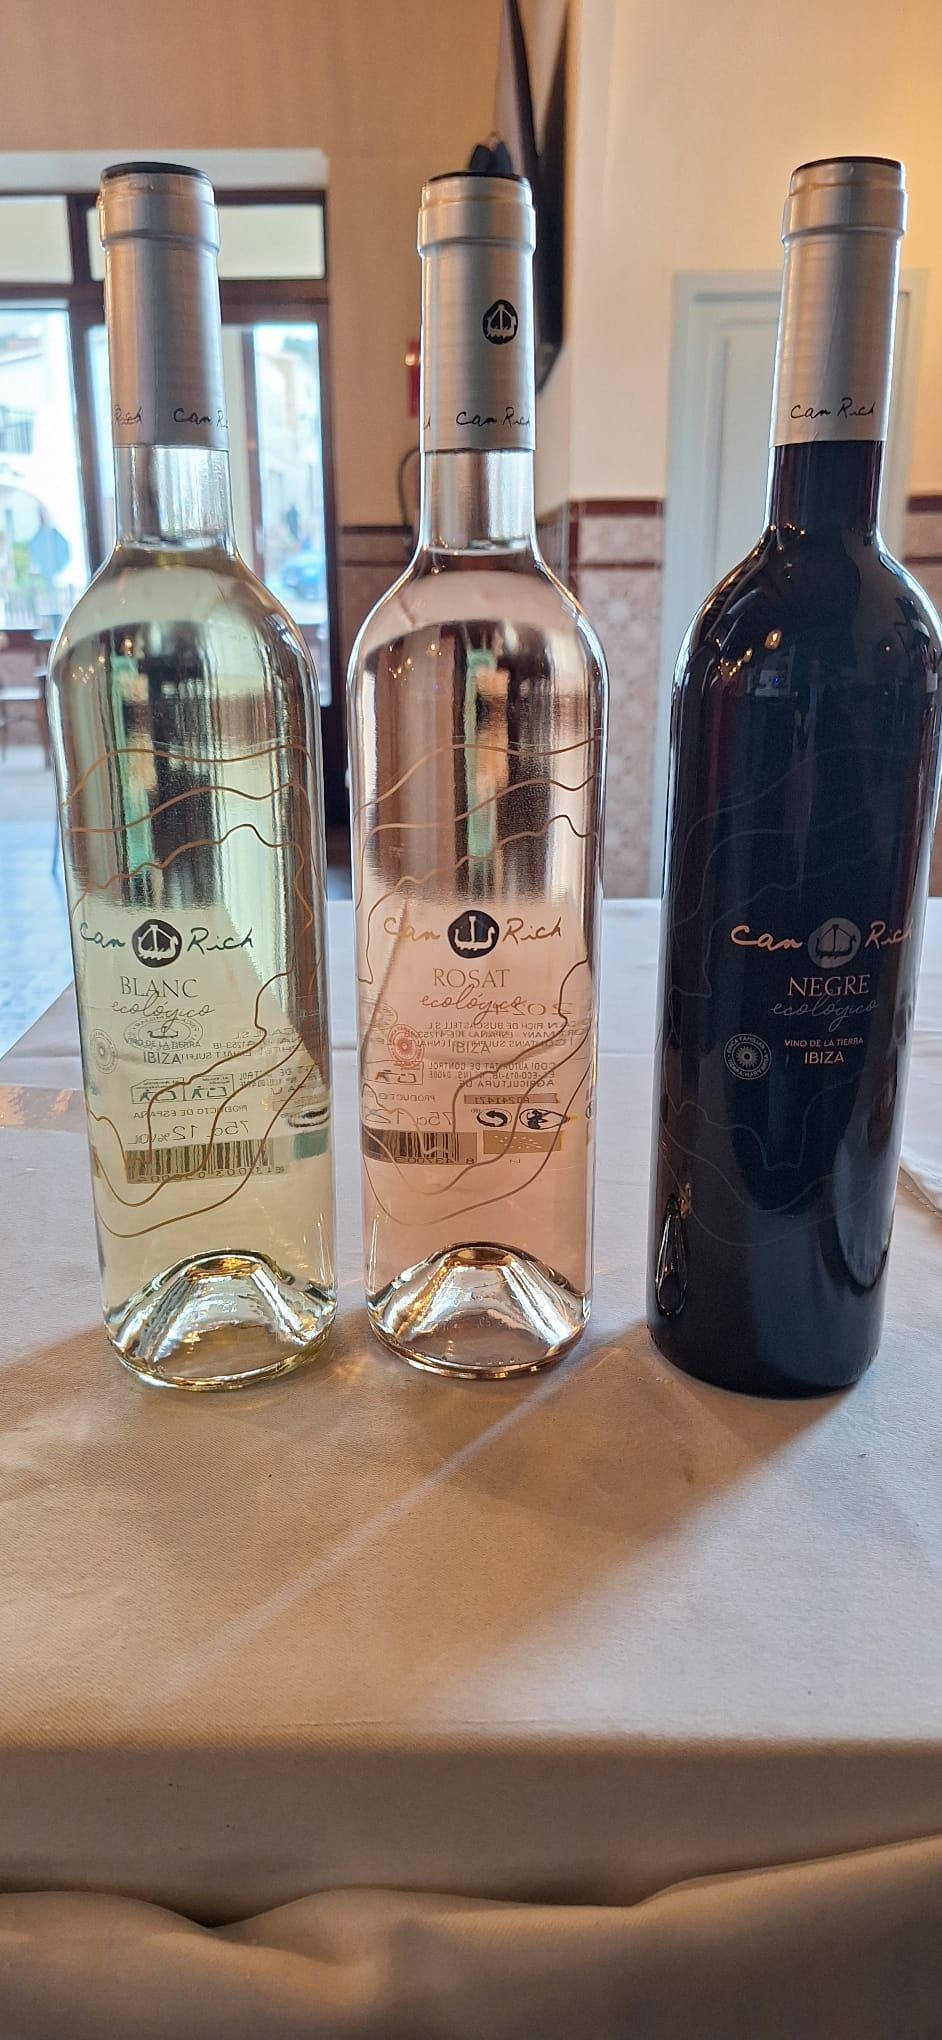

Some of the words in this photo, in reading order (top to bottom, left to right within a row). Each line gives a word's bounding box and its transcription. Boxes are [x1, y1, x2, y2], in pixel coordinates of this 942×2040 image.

[173, 407, 211, 425] Can
[455, 411, 498, 426] Can
[790, 404, 831, 419] Can
[838, 397, 876, 418] Rich
[79, 922, 126, 948] Can
[187, 927, 254, 955] Rich
[384, 917, 441, 942] Can
[502, 917, 562, 945] Rich
[730, 924, 803, 951] Can
[119, 975, 200, 998] BLANC
[432, 968, 511, 988] ROSAT
[787, 974, 870, 997] NEGRE
[111, 990, 217, 1034] ecológico
[421, 984, 527, 1024] ecológico
[770, 993, 880, 1032] ecológico
[784, 1039, 807, 1047] VINO
[809, 1039, 821, 1047] DE
[823, 1039, 835, 1047] LA
[837, 1037, 864, 1046] TIERRA
[143, 1051, 182, 1064] IBIZA
[804, 1052, 845, 1064] IBIZA
